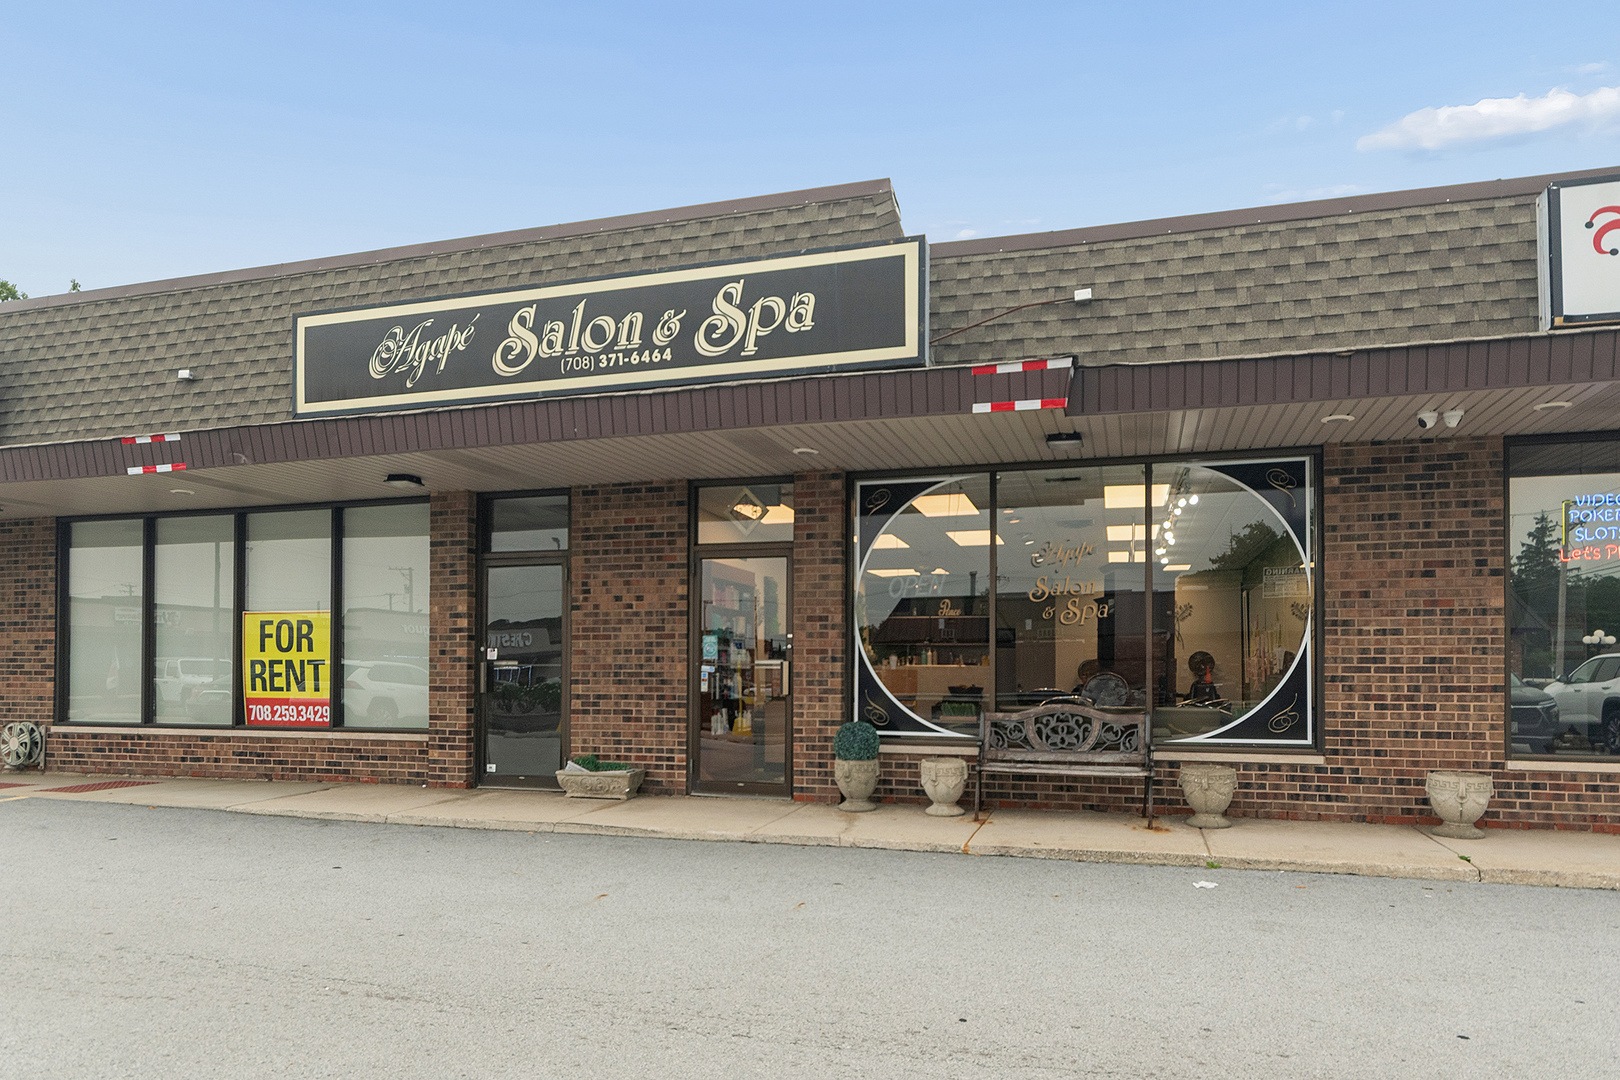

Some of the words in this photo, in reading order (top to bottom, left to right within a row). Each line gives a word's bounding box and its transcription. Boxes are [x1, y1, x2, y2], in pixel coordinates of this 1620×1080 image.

[368, 313, 481, 388] Agapé
[492, 298, 644, 376] Salon
[652, 308, 687, 346] &
[694, 279, 816, 356] Spa
[561, 354, 595, 374] (708)
[599, 348, 672, 367] 371-6464
[1575, 526, 1620, 542] SLOT
[1560, 545, 1601, 562] Let's
[889, 575, 946, 598] OPEN
[1029, 576, 1096, 602] Salon
[1042, 606, 1056, 619] &
[1060, 597, 1109, 625] Spa
[259, 619, 314, 653] FOR
[250, 659, 326, 692] RENT
[249, 705, 330, 722] 708.259.3429
